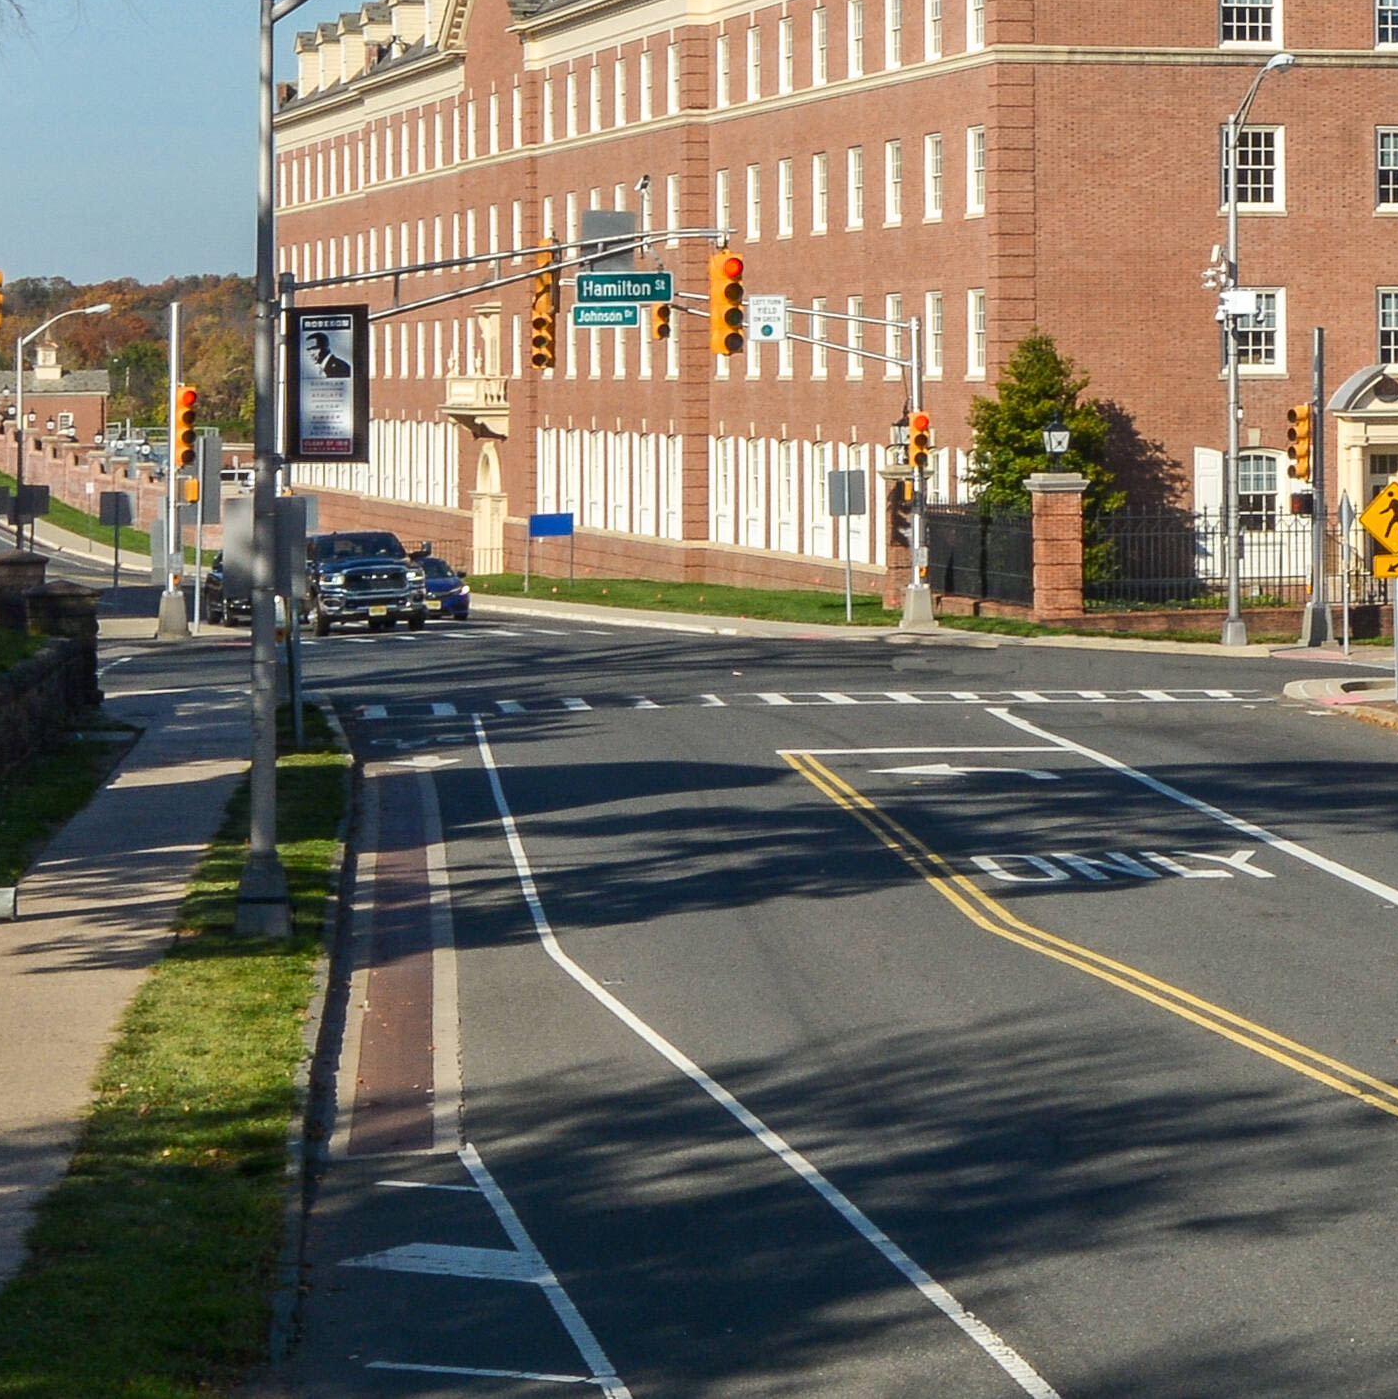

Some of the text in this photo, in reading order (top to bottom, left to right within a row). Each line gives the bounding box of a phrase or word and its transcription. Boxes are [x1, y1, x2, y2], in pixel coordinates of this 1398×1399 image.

[583, 279, 666, 296] Hamilton St
[577, 309, 634, 322] Johnson Dr
[969, 850, 1277, 882] ONLY
